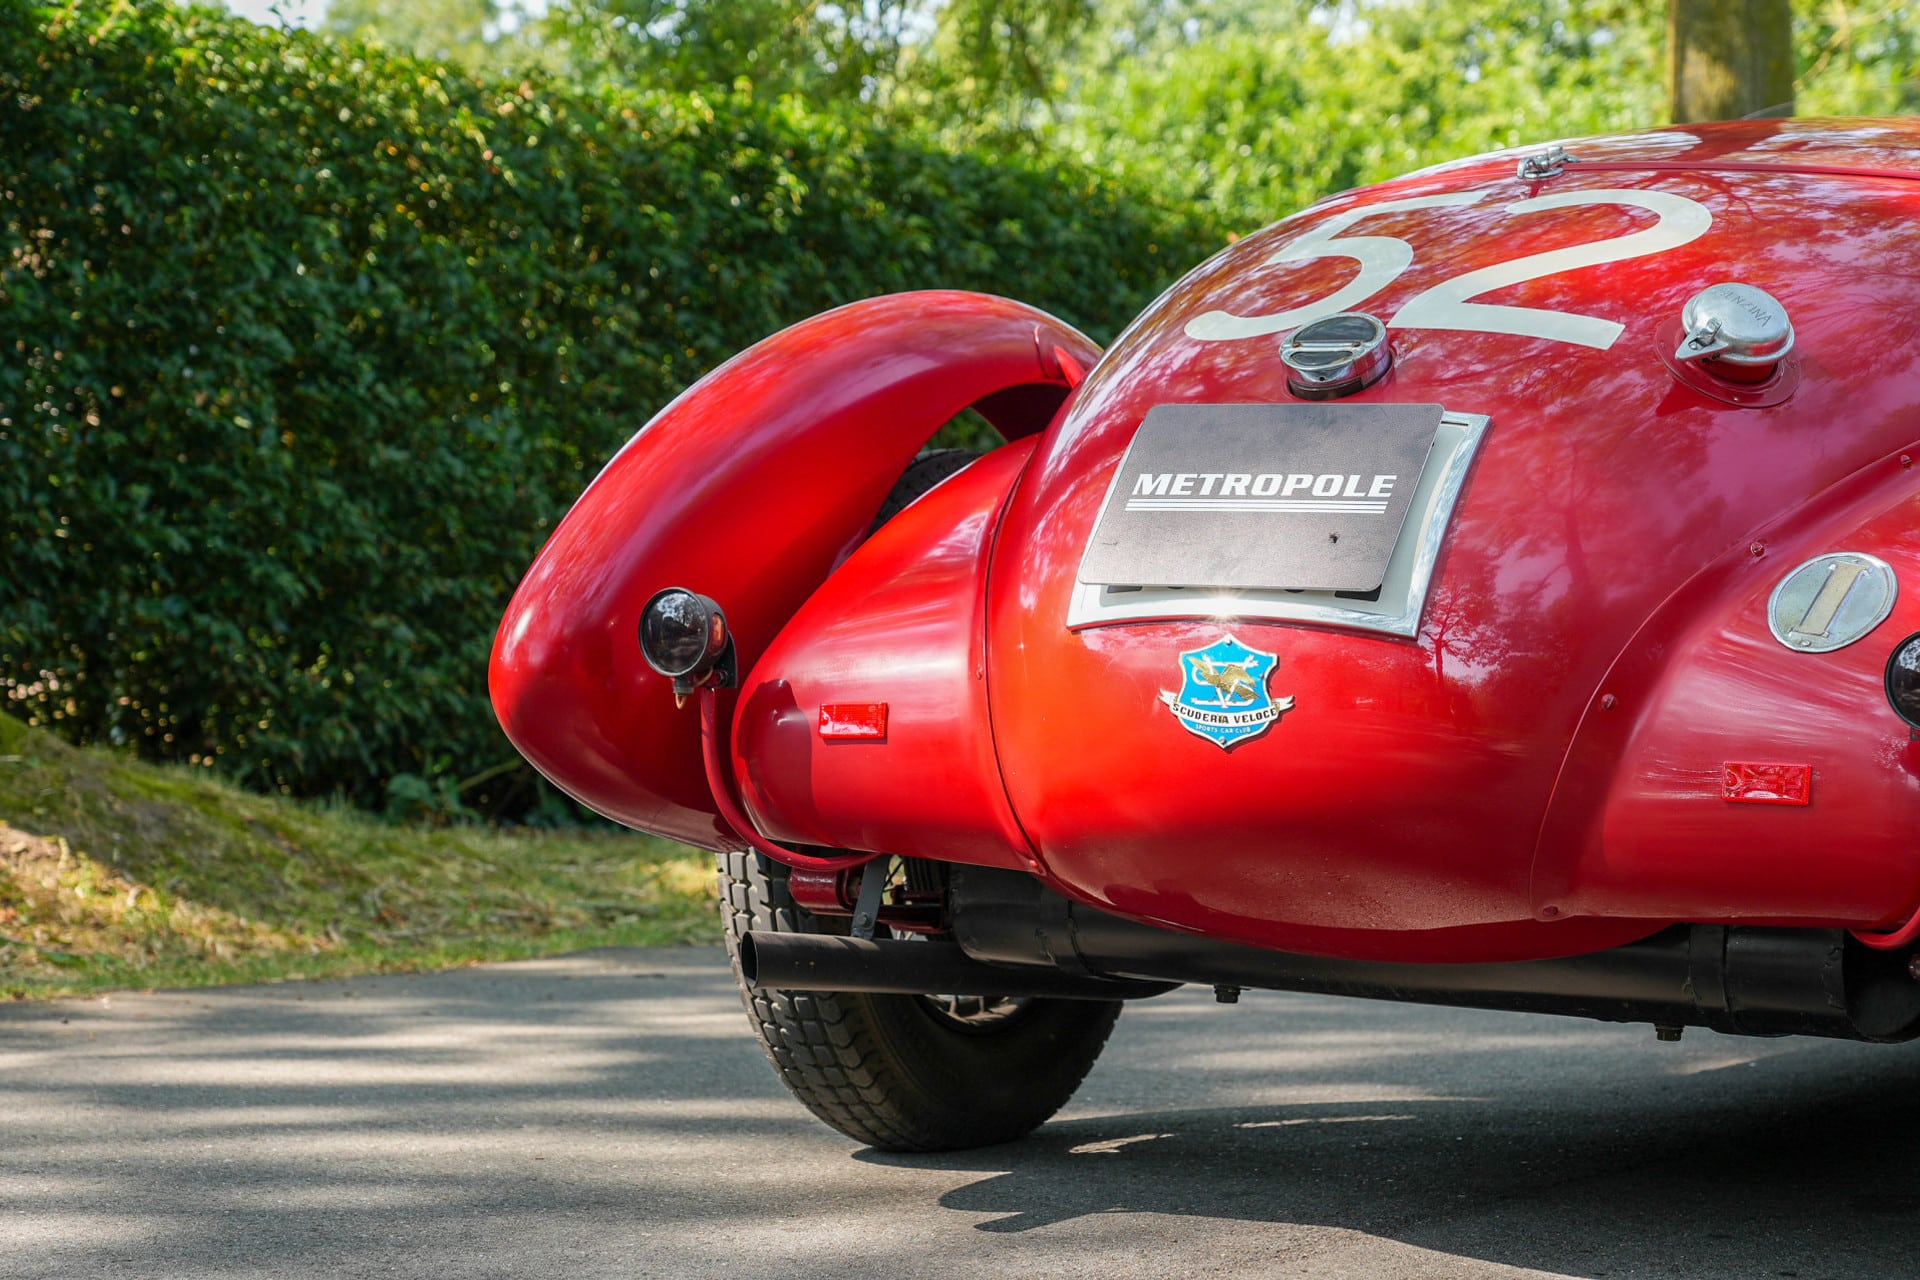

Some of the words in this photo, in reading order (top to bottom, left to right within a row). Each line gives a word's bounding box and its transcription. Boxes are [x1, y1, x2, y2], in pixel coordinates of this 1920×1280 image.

[1184, 189, 1713, 350] 52
[1131, 472, 1398, 498] METROPOLE
[1172, 703, 1229, 724] SCUDERIA
[1233, 707, 1277, 724] VELOCE
[1195, 723, 1218, 733] SPORTS
[1235, 726, 1251, 734] CLUB
